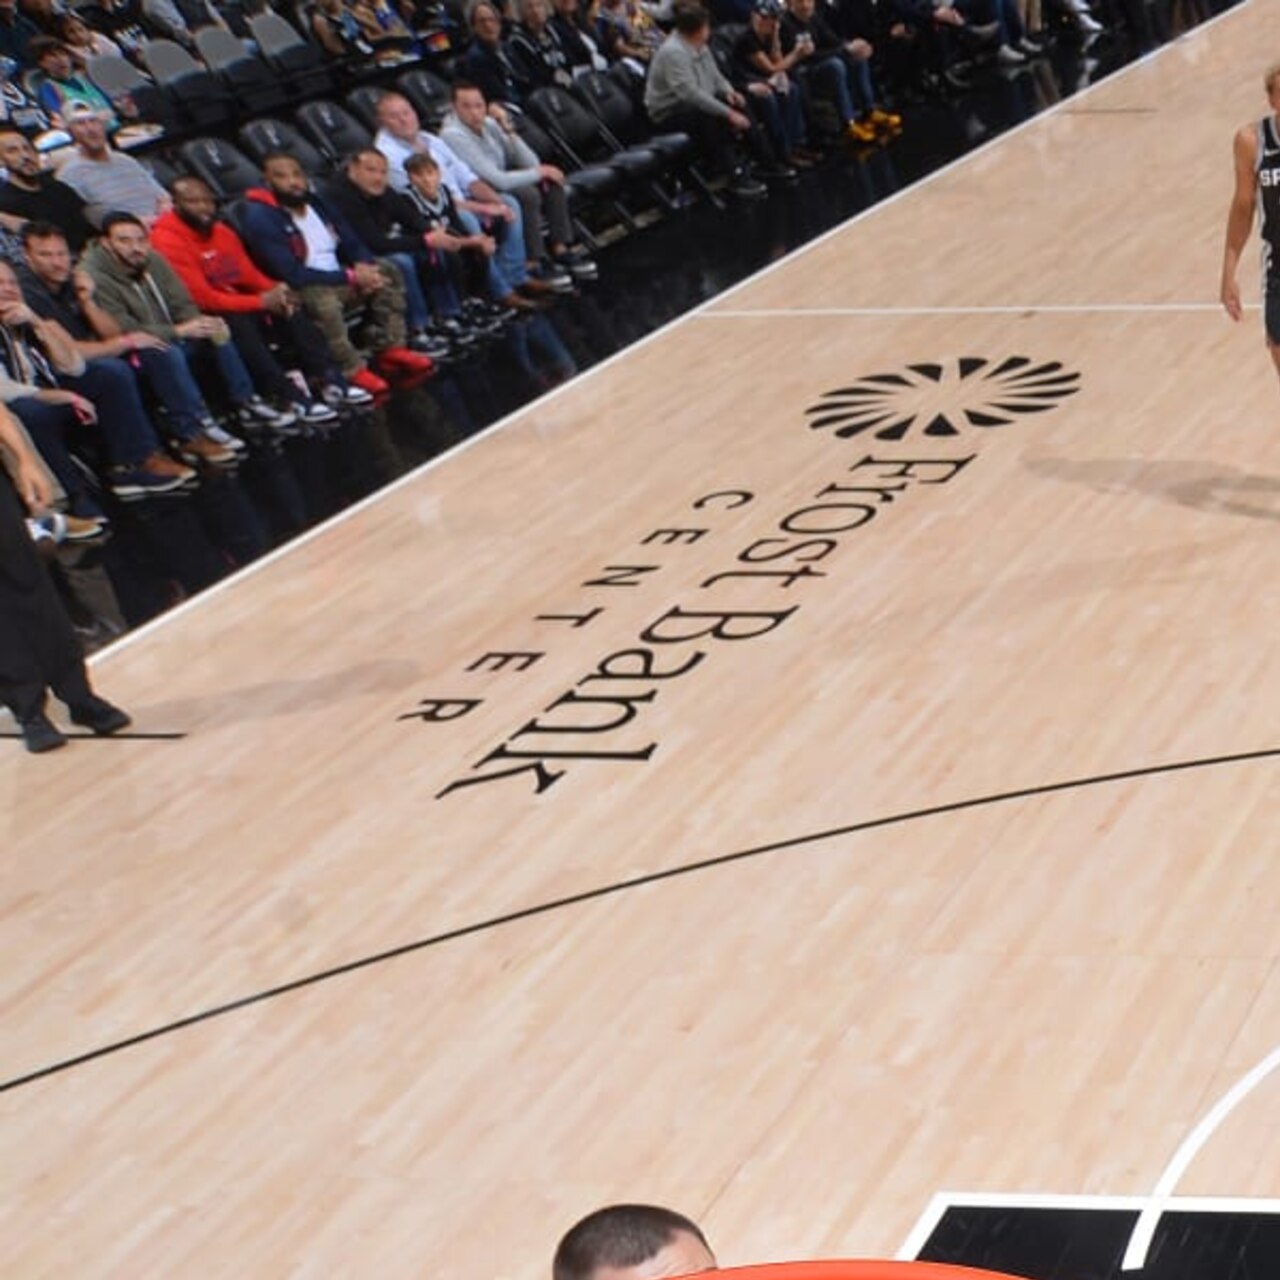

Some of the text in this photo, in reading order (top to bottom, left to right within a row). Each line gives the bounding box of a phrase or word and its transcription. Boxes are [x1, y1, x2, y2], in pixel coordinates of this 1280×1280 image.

[396, 490, 754, 723] CENTER
[434, 453, 977, 799] Frost Bank
